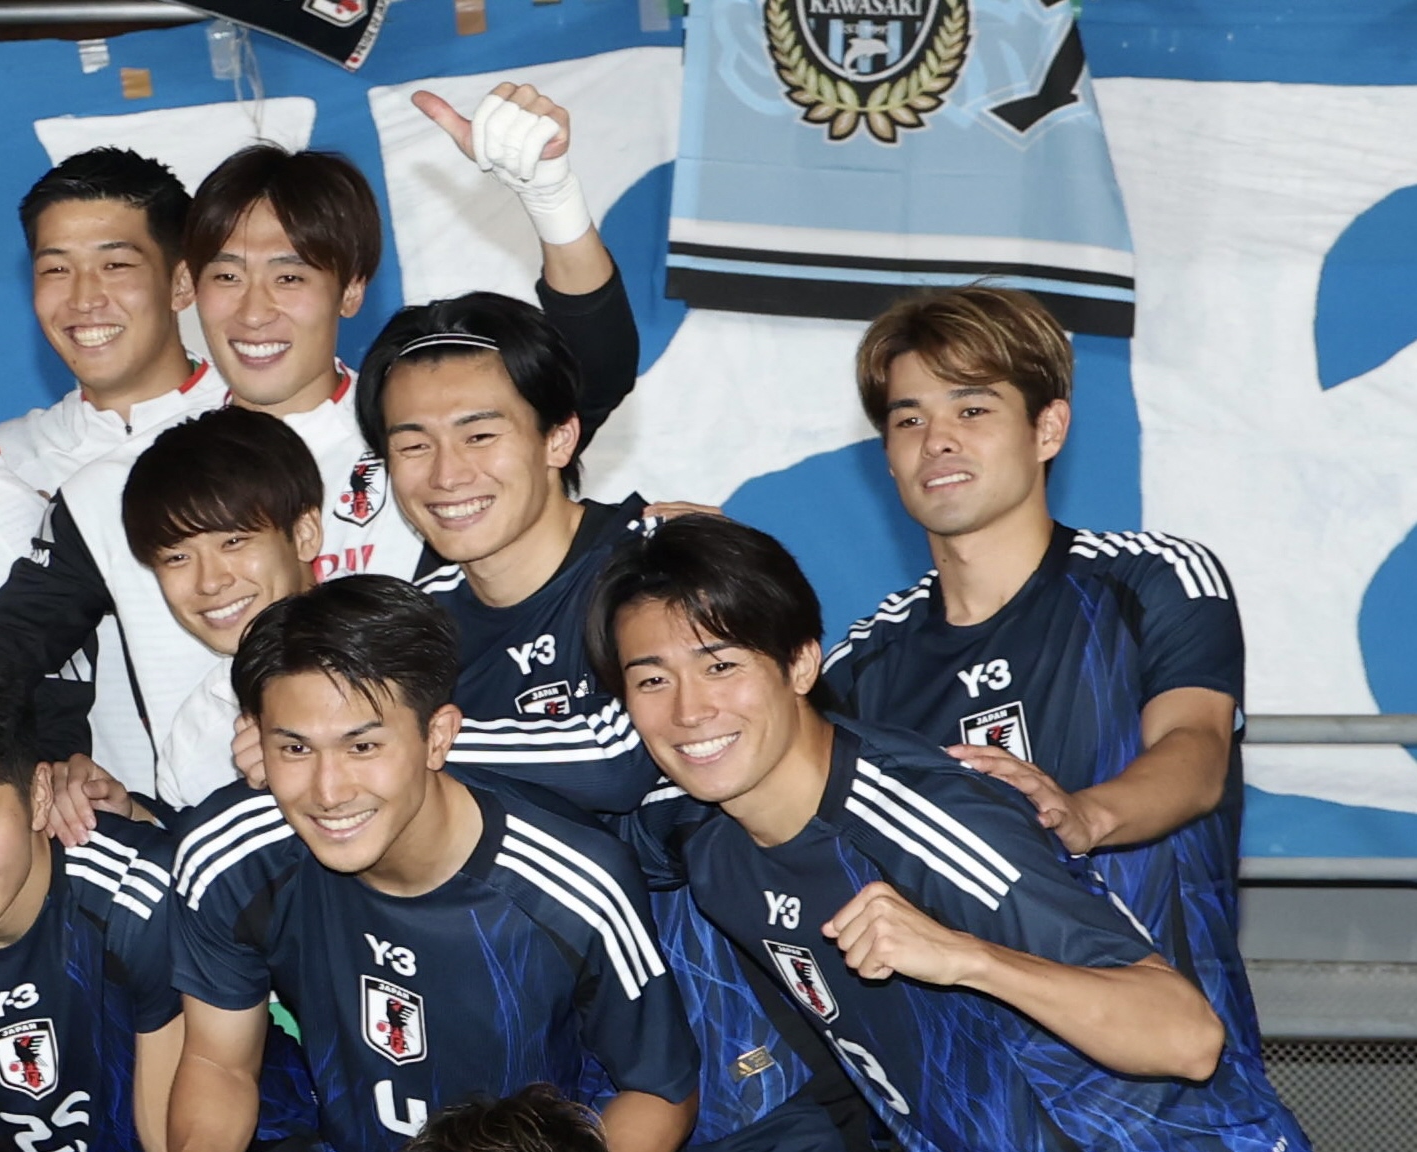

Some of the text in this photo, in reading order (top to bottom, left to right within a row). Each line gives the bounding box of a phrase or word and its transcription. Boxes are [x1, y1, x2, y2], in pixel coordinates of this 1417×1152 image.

[507, 634, 556, 676] Y-3
[956, 659, 1012, 698] Y-3
[975, 708, 1008, 727] JAPAN
[763, 890, 802, 930] Y-3
[364, 933, 417, 978] Y-3
